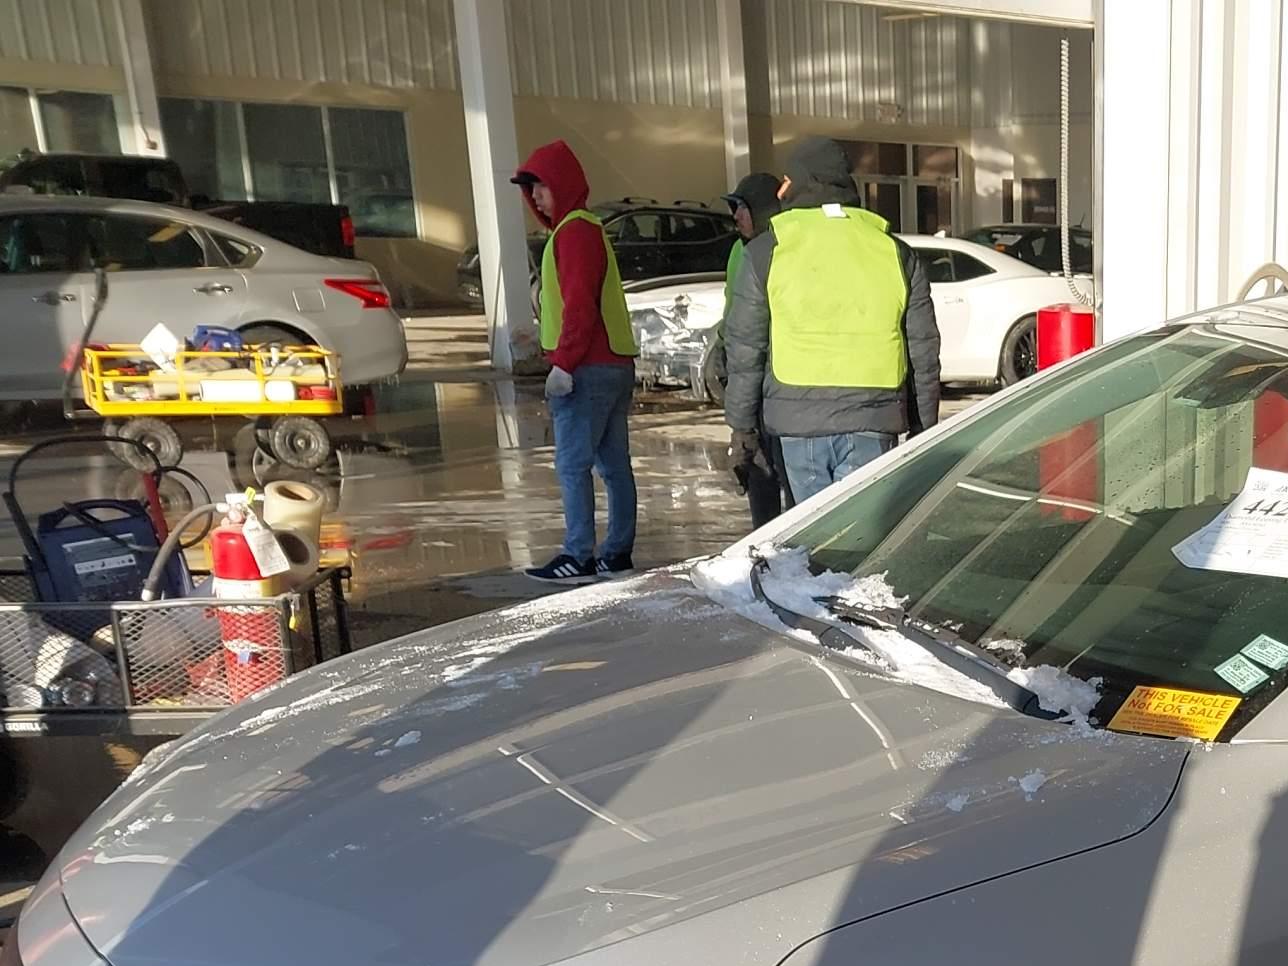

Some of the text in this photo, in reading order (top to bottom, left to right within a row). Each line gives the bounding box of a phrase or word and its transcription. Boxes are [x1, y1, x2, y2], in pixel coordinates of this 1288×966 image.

[1136, 689, 1233, 709] THIS VEHICLE
[1127, 699, 1151, 711] Not
[1153, 702, 1184, 715] FOR
[1187, 706, 1228, 720] SALE
